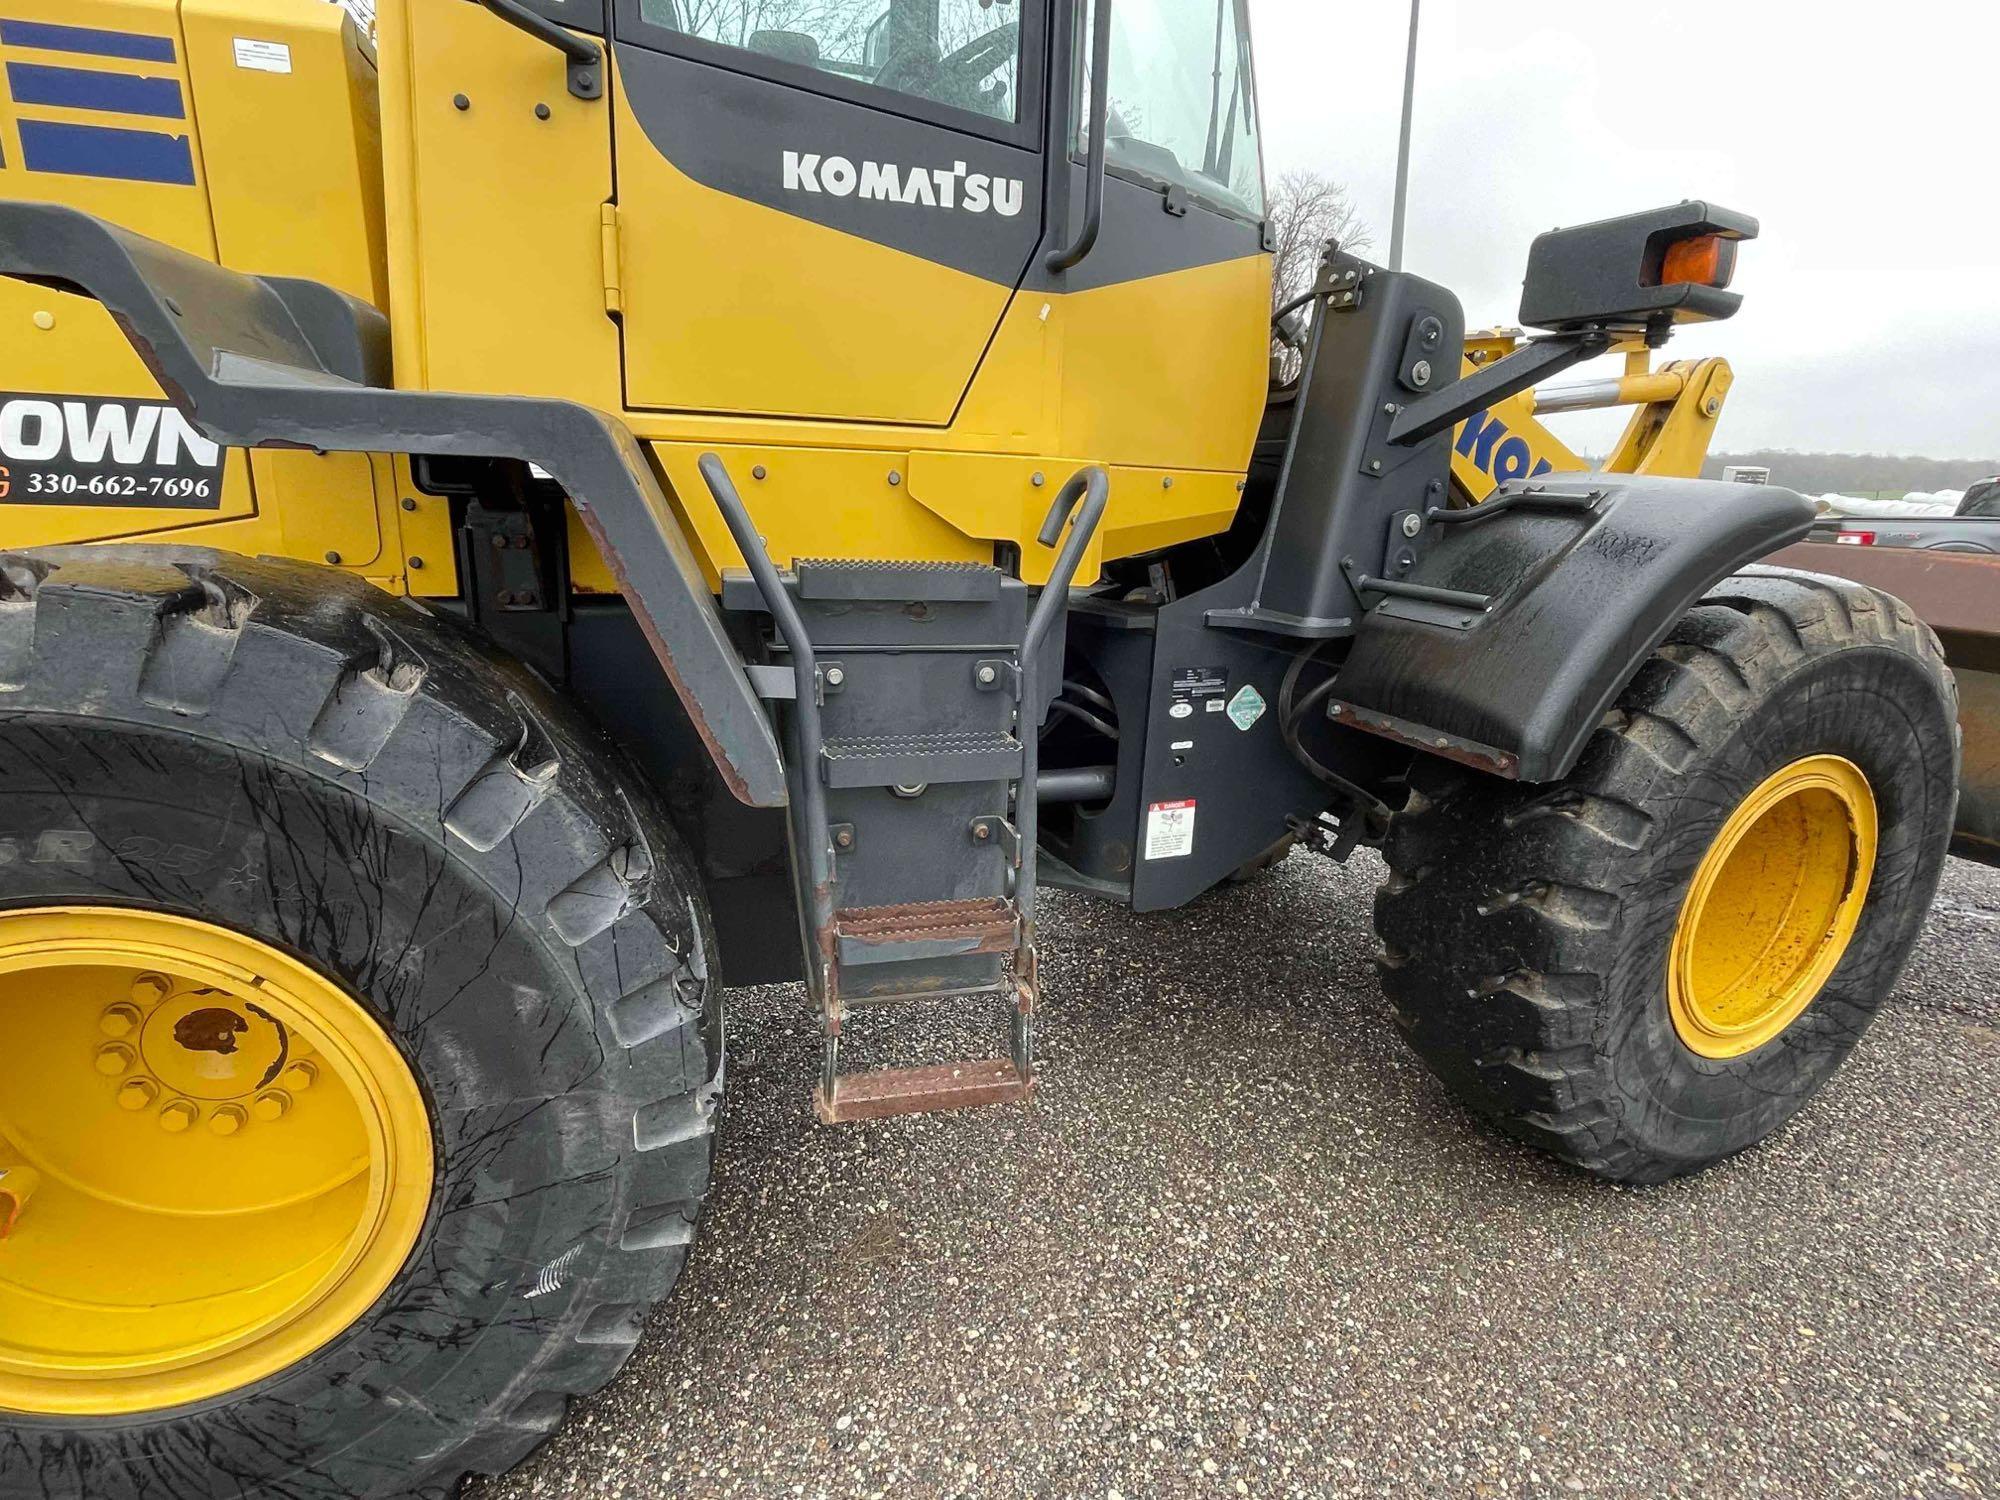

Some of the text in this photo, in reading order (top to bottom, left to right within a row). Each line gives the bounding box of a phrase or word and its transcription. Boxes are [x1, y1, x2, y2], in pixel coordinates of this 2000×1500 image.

[783, 151, 1023, 216] KOMATSU
[0, 400, 219, 466] OWN
[1455, 410, 1552, 485] KO
[28, 473, 209, 497] 330-662-7696
